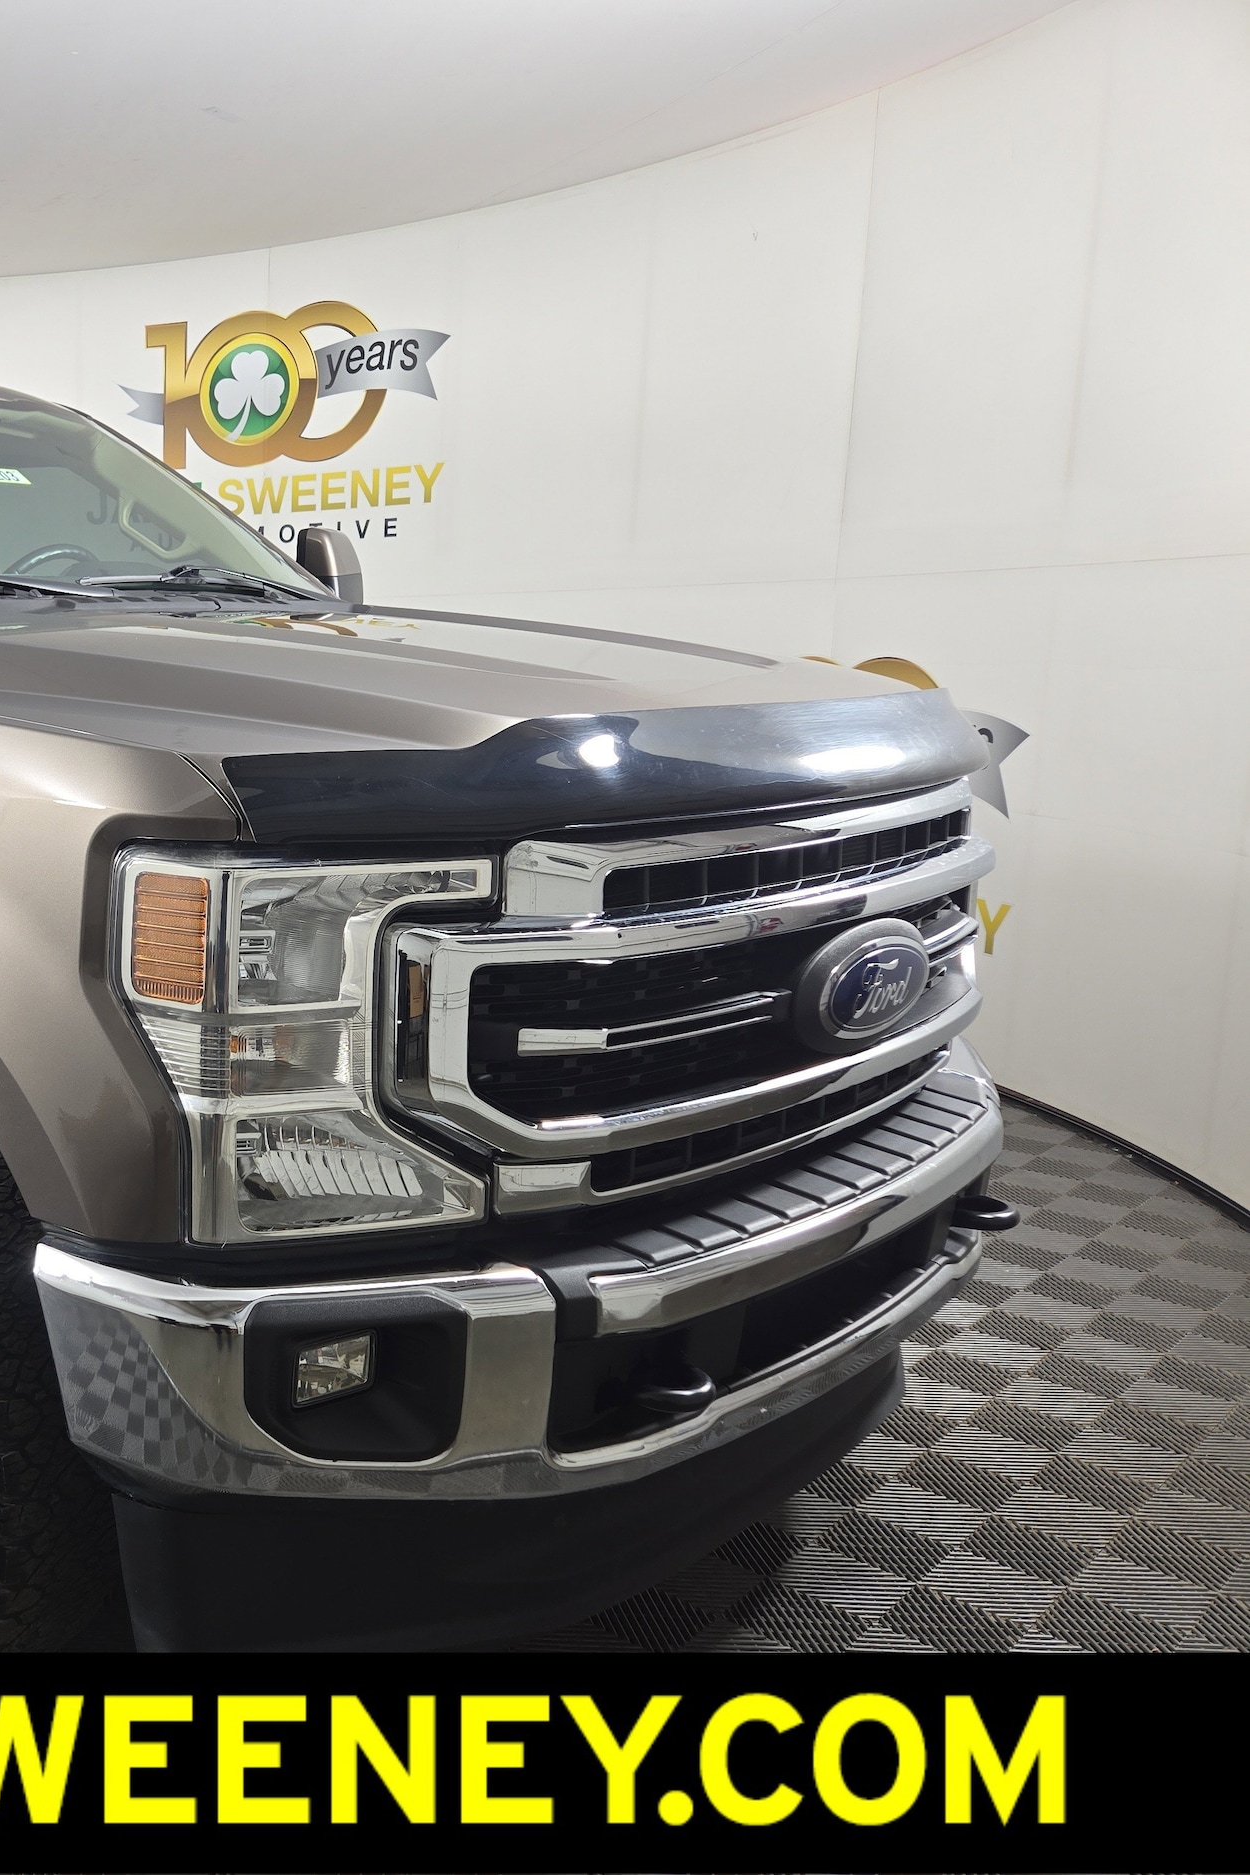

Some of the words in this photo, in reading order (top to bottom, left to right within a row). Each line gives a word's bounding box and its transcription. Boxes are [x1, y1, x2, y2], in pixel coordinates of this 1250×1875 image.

[324, 338, 420, 390] years
[218, 462, 445, 517] SWEENEY
[853, 958, 913, 1020] Ford
